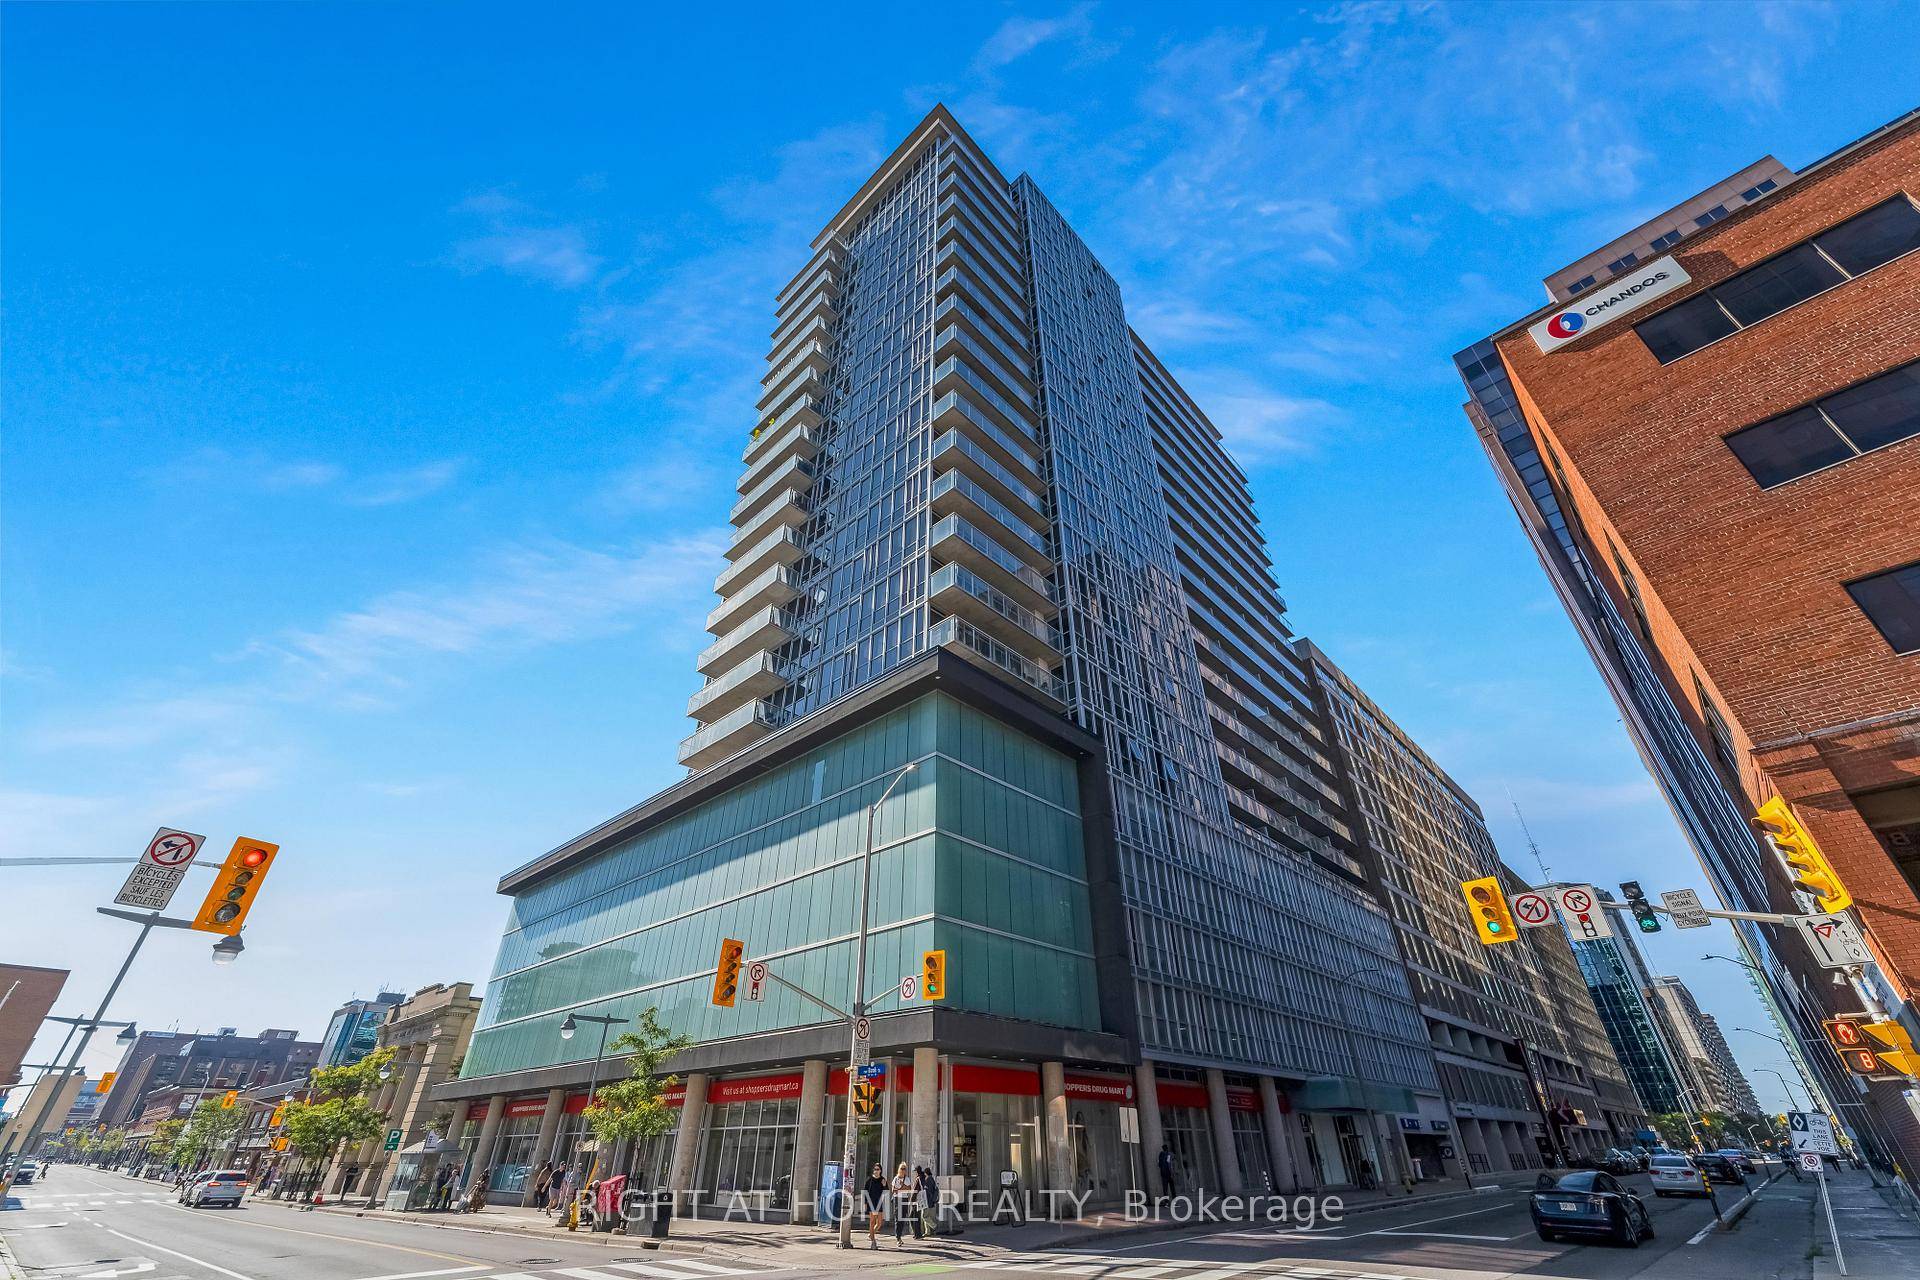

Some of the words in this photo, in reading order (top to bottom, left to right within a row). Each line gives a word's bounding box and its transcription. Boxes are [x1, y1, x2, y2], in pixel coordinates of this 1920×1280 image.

[1586, 272, 1669, 316] CHANDOS
[137, 867, 179, 881] BICYCLES
[132, 875, 174, 889] EXCEPTED
[130, 885, 150, 896] SAUF
[150, 888, 165, 899] LES
[120, 893, 165, 908] BICYCLETTES
[1860, 1053, 1874, 1068] 8
[1092, 1085, 1108, 1094] DRUG
[1109, 1087, 1124, 1095] MART
[389, 1130, 400, 1143] P
